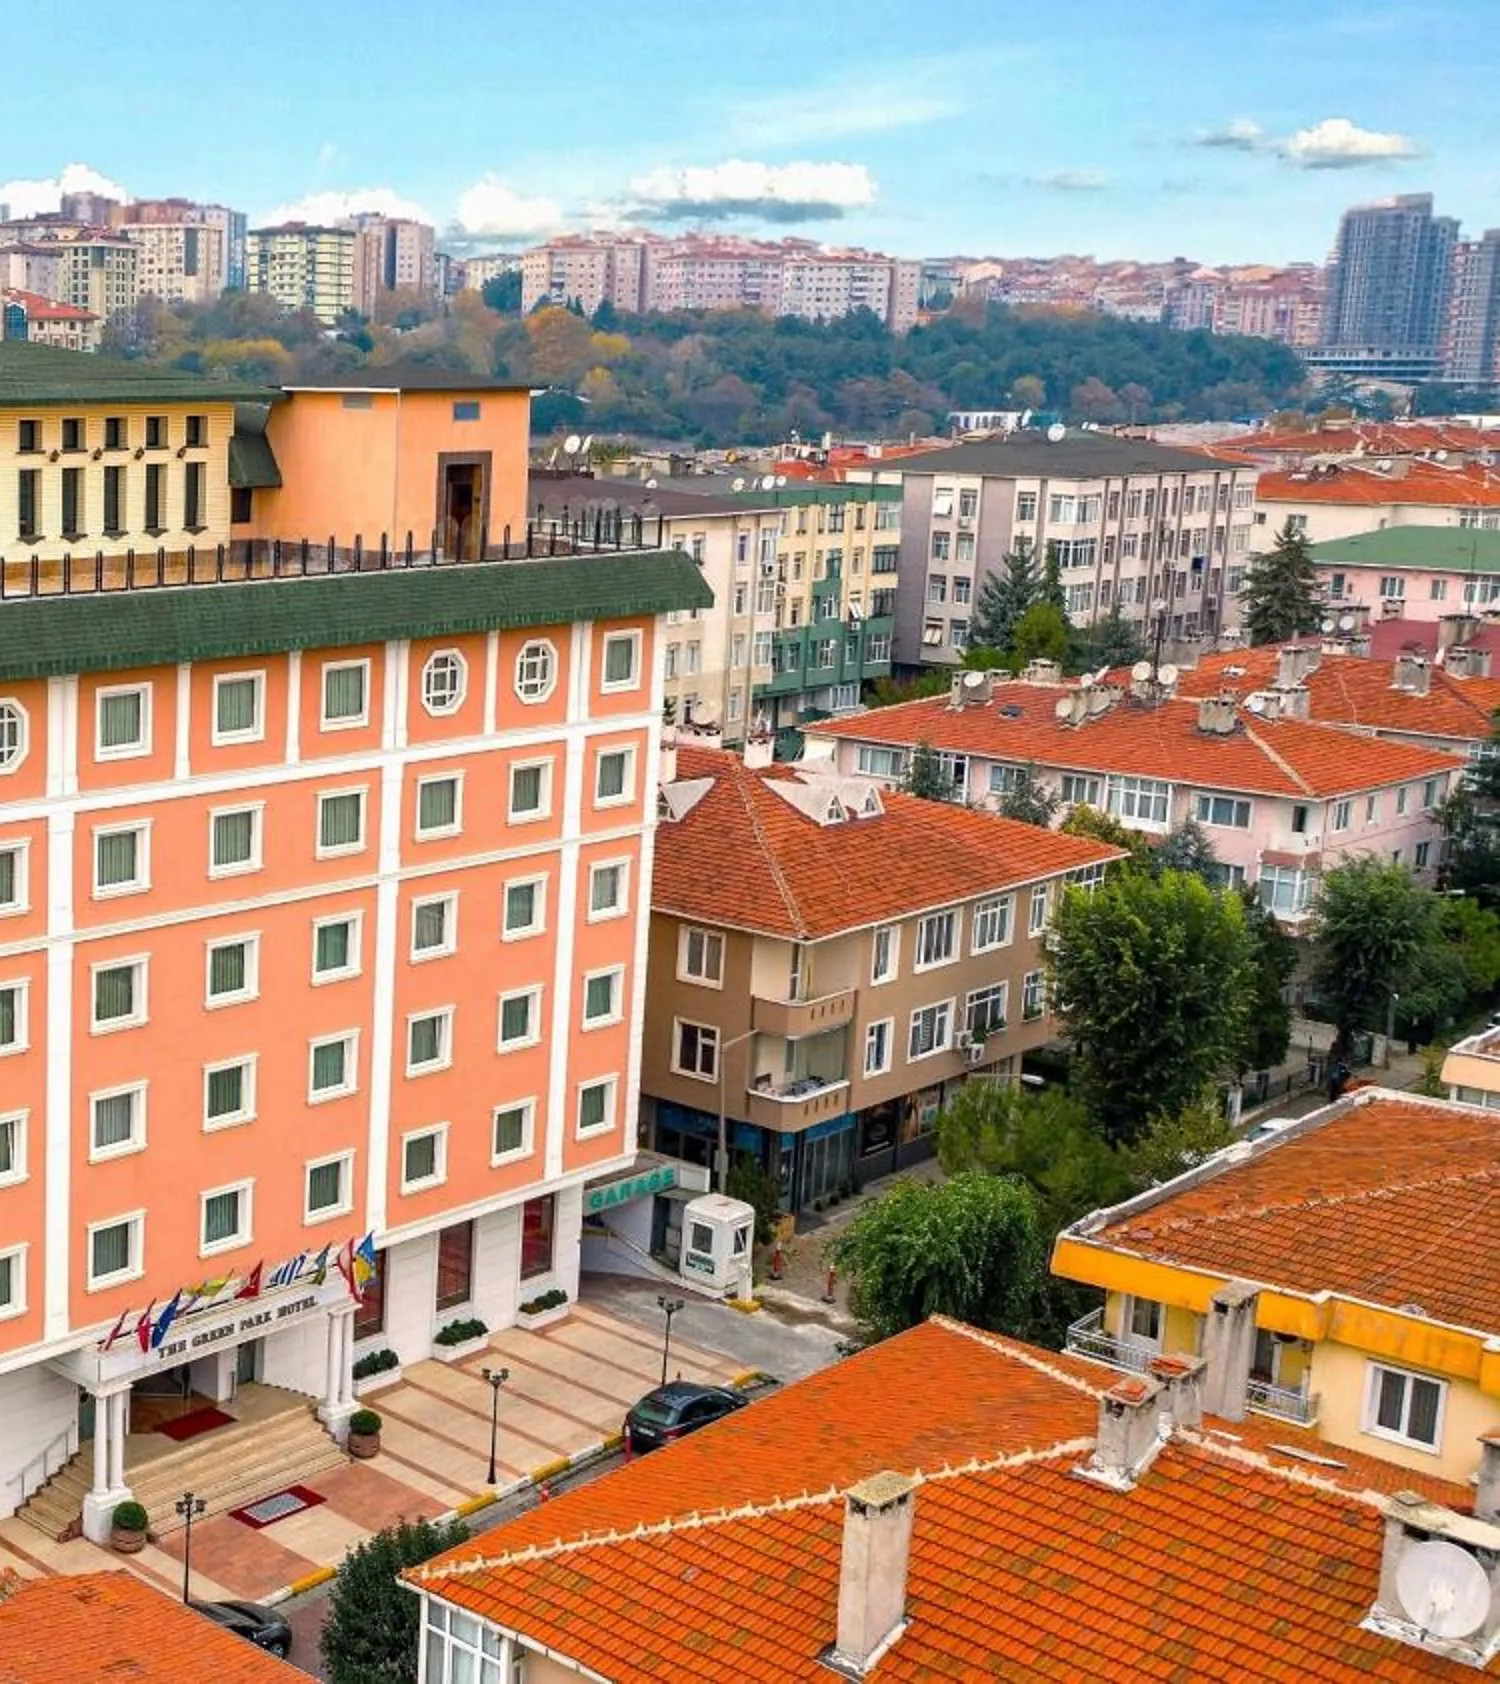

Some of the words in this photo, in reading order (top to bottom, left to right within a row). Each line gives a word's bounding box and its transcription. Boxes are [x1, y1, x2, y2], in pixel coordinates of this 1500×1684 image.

[590, 1167, 675, 1209] GARAGE
[158, 1340, 187, 1358] THE
[191, 1323, 235, 1346] GREEN
[239, 1310, 273, 1331] PARK
[276, 1295, 318, 1318] HOTEL
